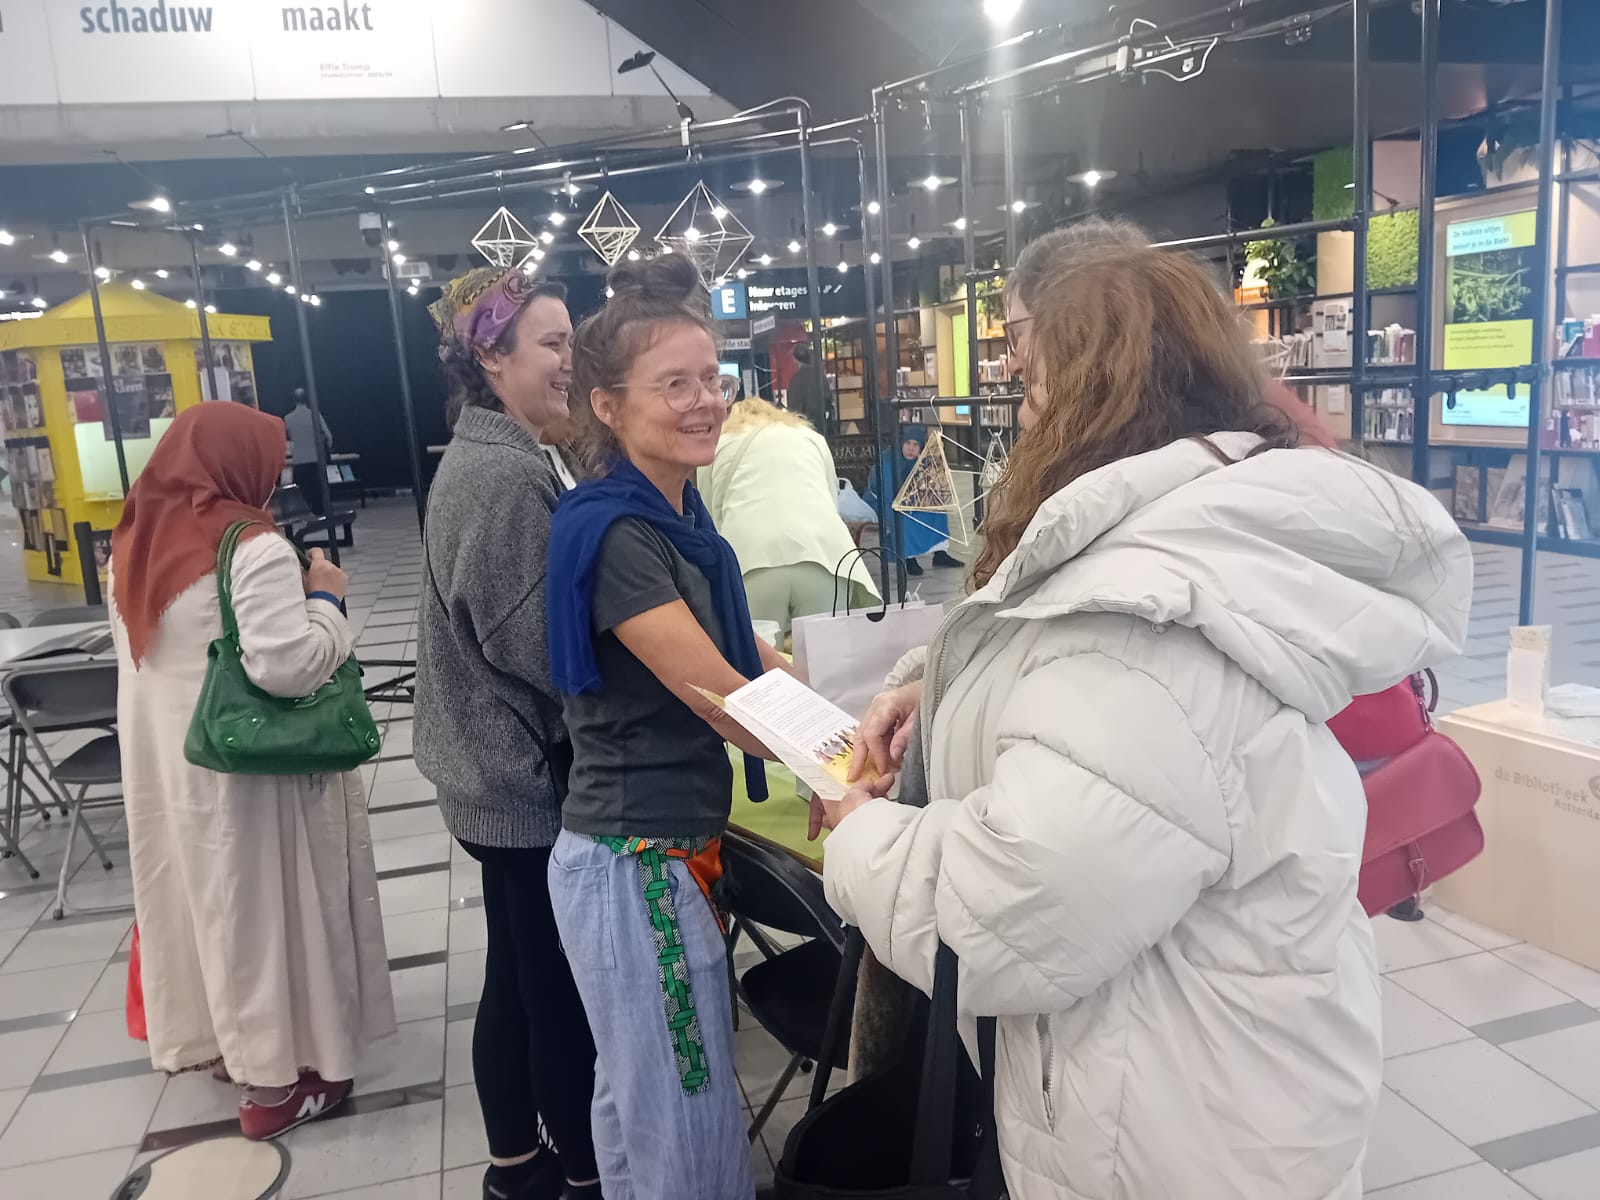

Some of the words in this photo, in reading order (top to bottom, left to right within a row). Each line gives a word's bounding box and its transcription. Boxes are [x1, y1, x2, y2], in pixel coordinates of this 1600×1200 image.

[80, 0, 213, 33] schaduw
[281, 0, 374, 31] maakt
[721, 289, 736, 314] E
[775, 286, 808, 298] etages
[1494, 766, 1511, 782] de
[1554, 798, 1600, 820] Rotterda
